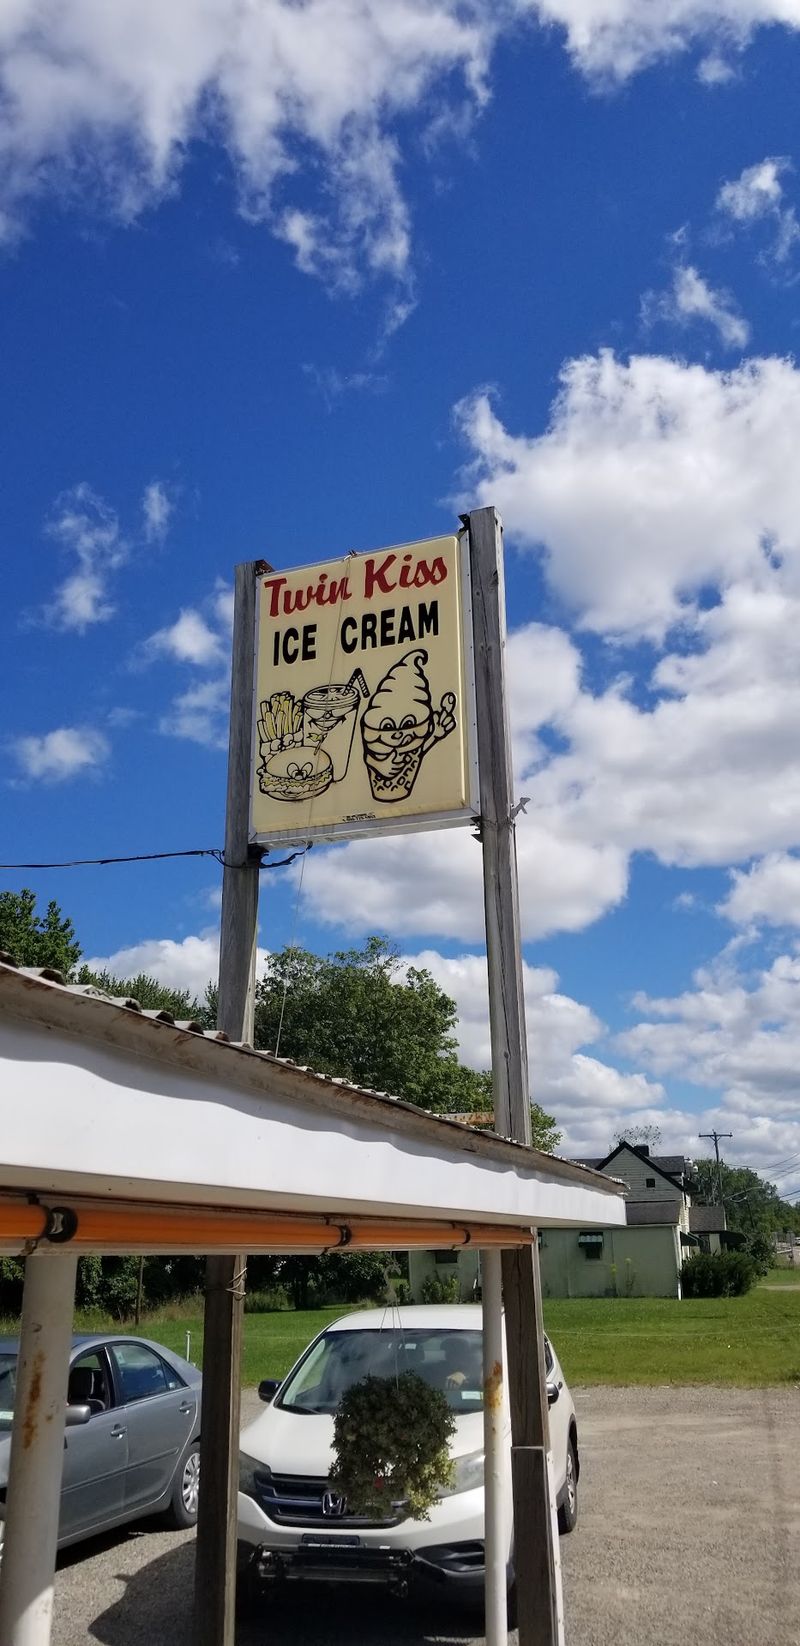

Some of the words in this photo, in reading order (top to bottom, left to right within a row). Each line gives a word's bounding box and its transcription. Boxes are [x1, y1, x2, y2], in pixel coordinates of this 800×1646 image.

[265, 573, 352, 617] Twin
[364, 554, 448, 599] Kiss
[273, 624, 317, 666] ICE
[341, 600, 439, 654] CREAM
